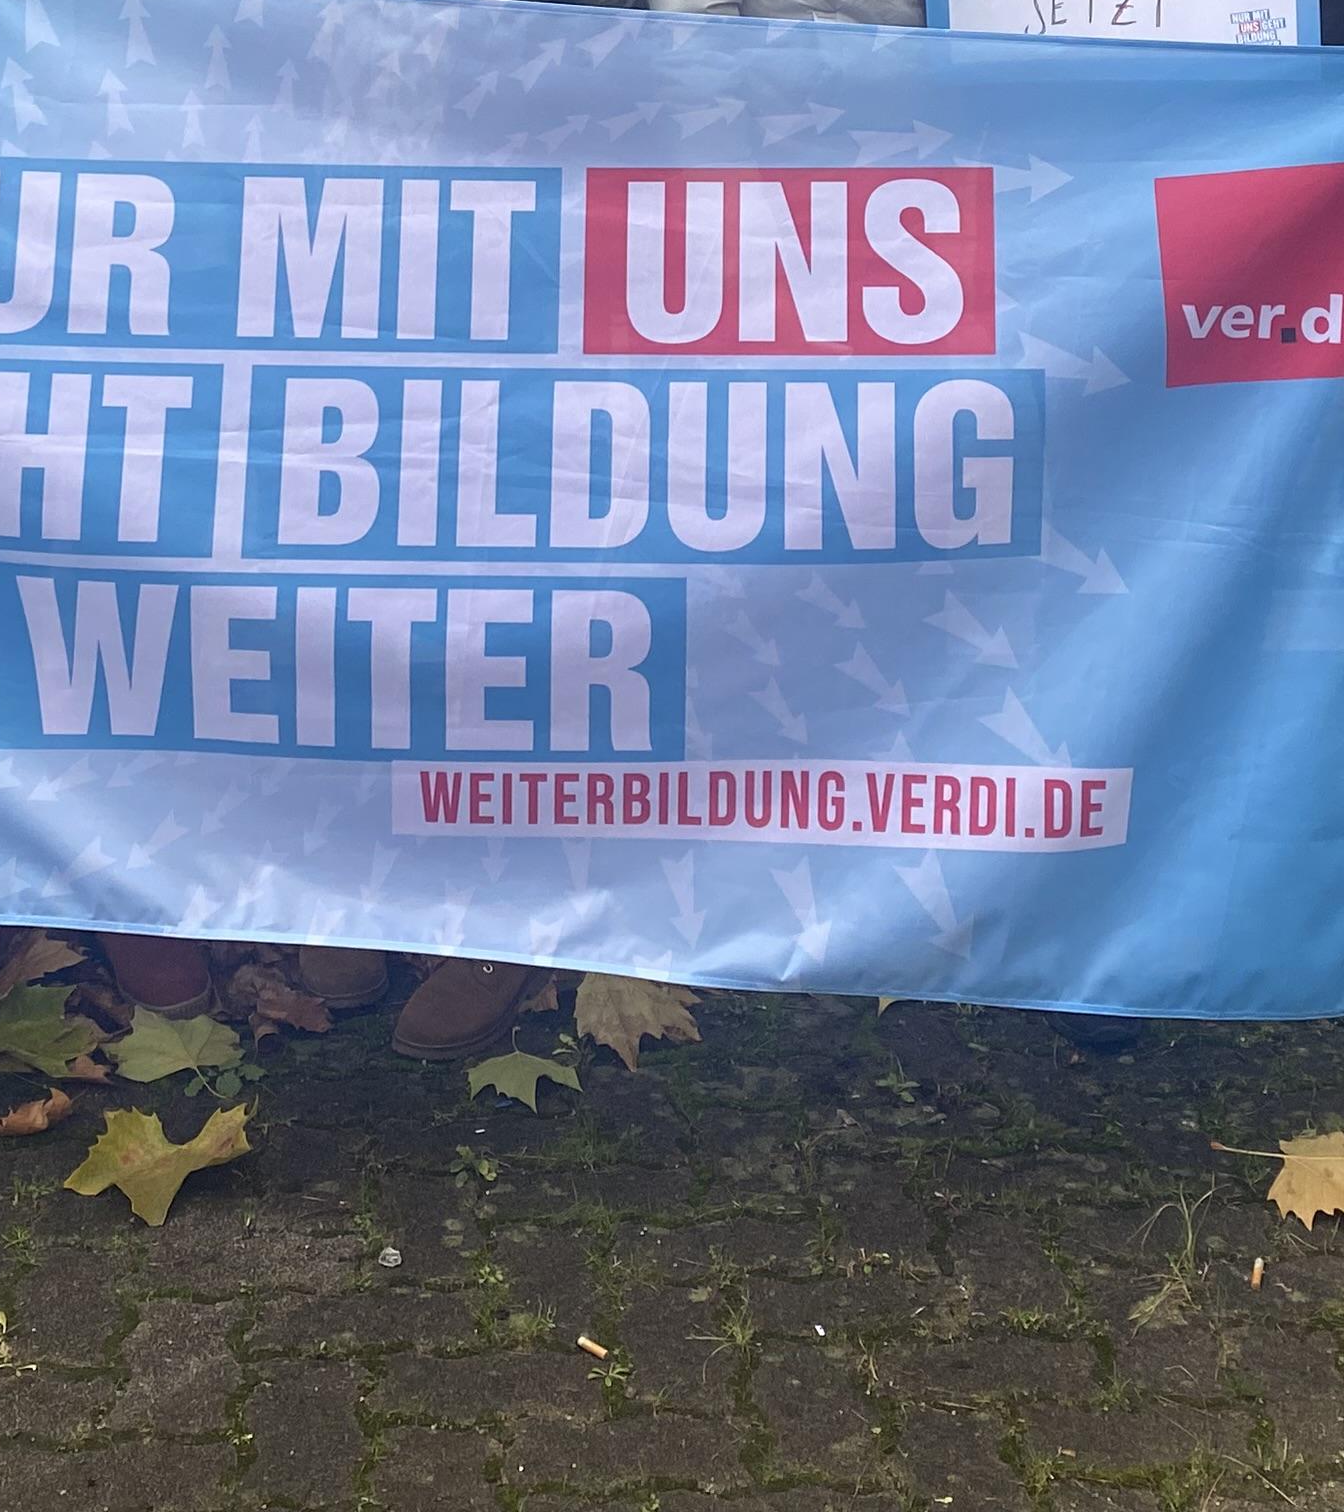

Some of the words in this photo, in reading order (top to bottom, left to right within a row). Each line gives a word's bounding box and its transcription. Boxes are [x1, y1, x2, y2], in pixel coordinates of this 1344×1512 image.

[1240, 21, 1260, 33] UNS
[1252, 9, 1270, 21] MIT
[236, 175, 537, 342] MIT
[625, 178, 964, 346] UNS
[277, 377, 1015, 553] BILDUNG
[16, 575, 653, 752] WEITER
[419, 770, 1108, 840] WEITERBILDUNG.VERDI.DE
